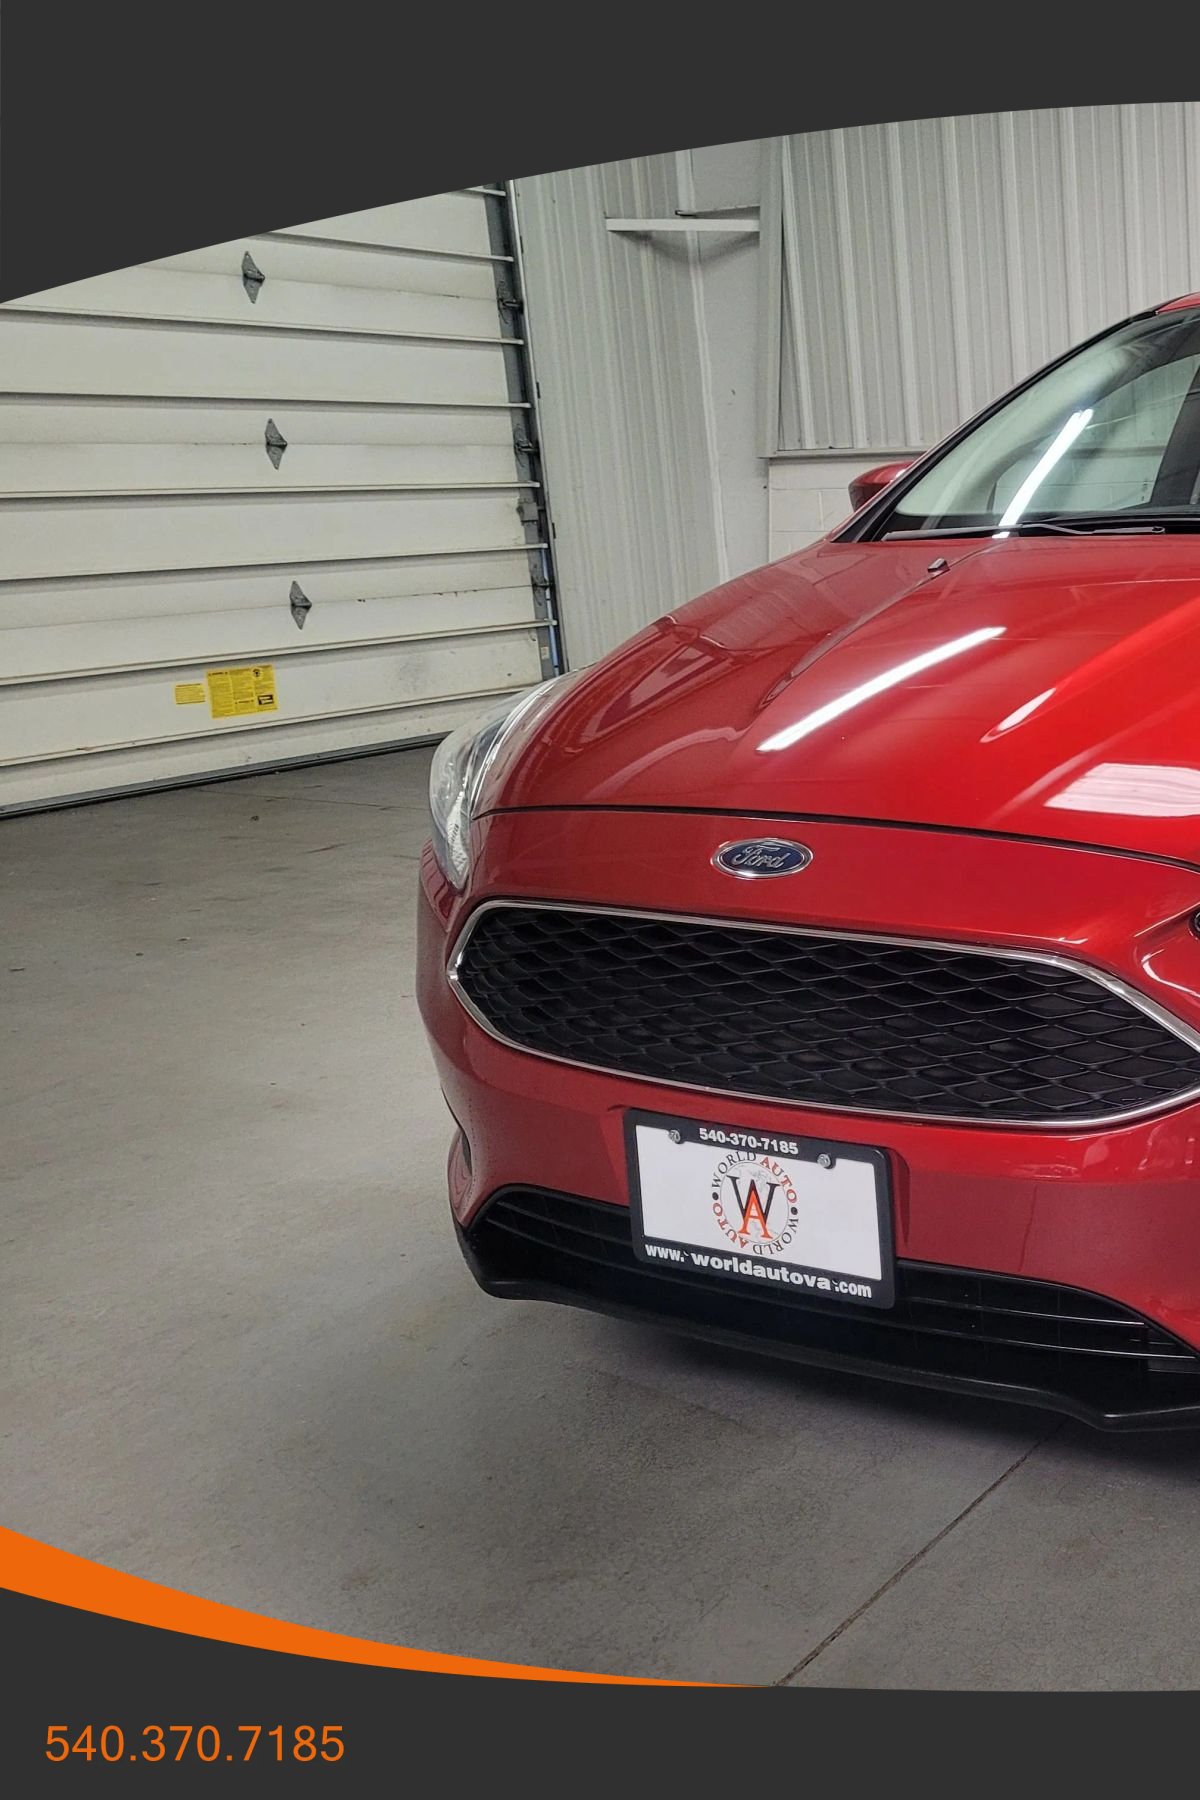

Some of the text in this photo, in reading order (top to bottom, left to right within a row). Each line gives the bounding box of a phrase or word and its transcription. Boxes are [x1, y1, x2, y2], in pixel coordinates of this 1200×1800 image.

[731, 845, 791, 869] Ford
[699, 1127, 799, 1155] 540-370-7185
[712, 1151, 798, 1203] WORLD AUTO
[712, 1203, 749, 1248] AUTO
[752, 1218, 799, 1255] WORLD
